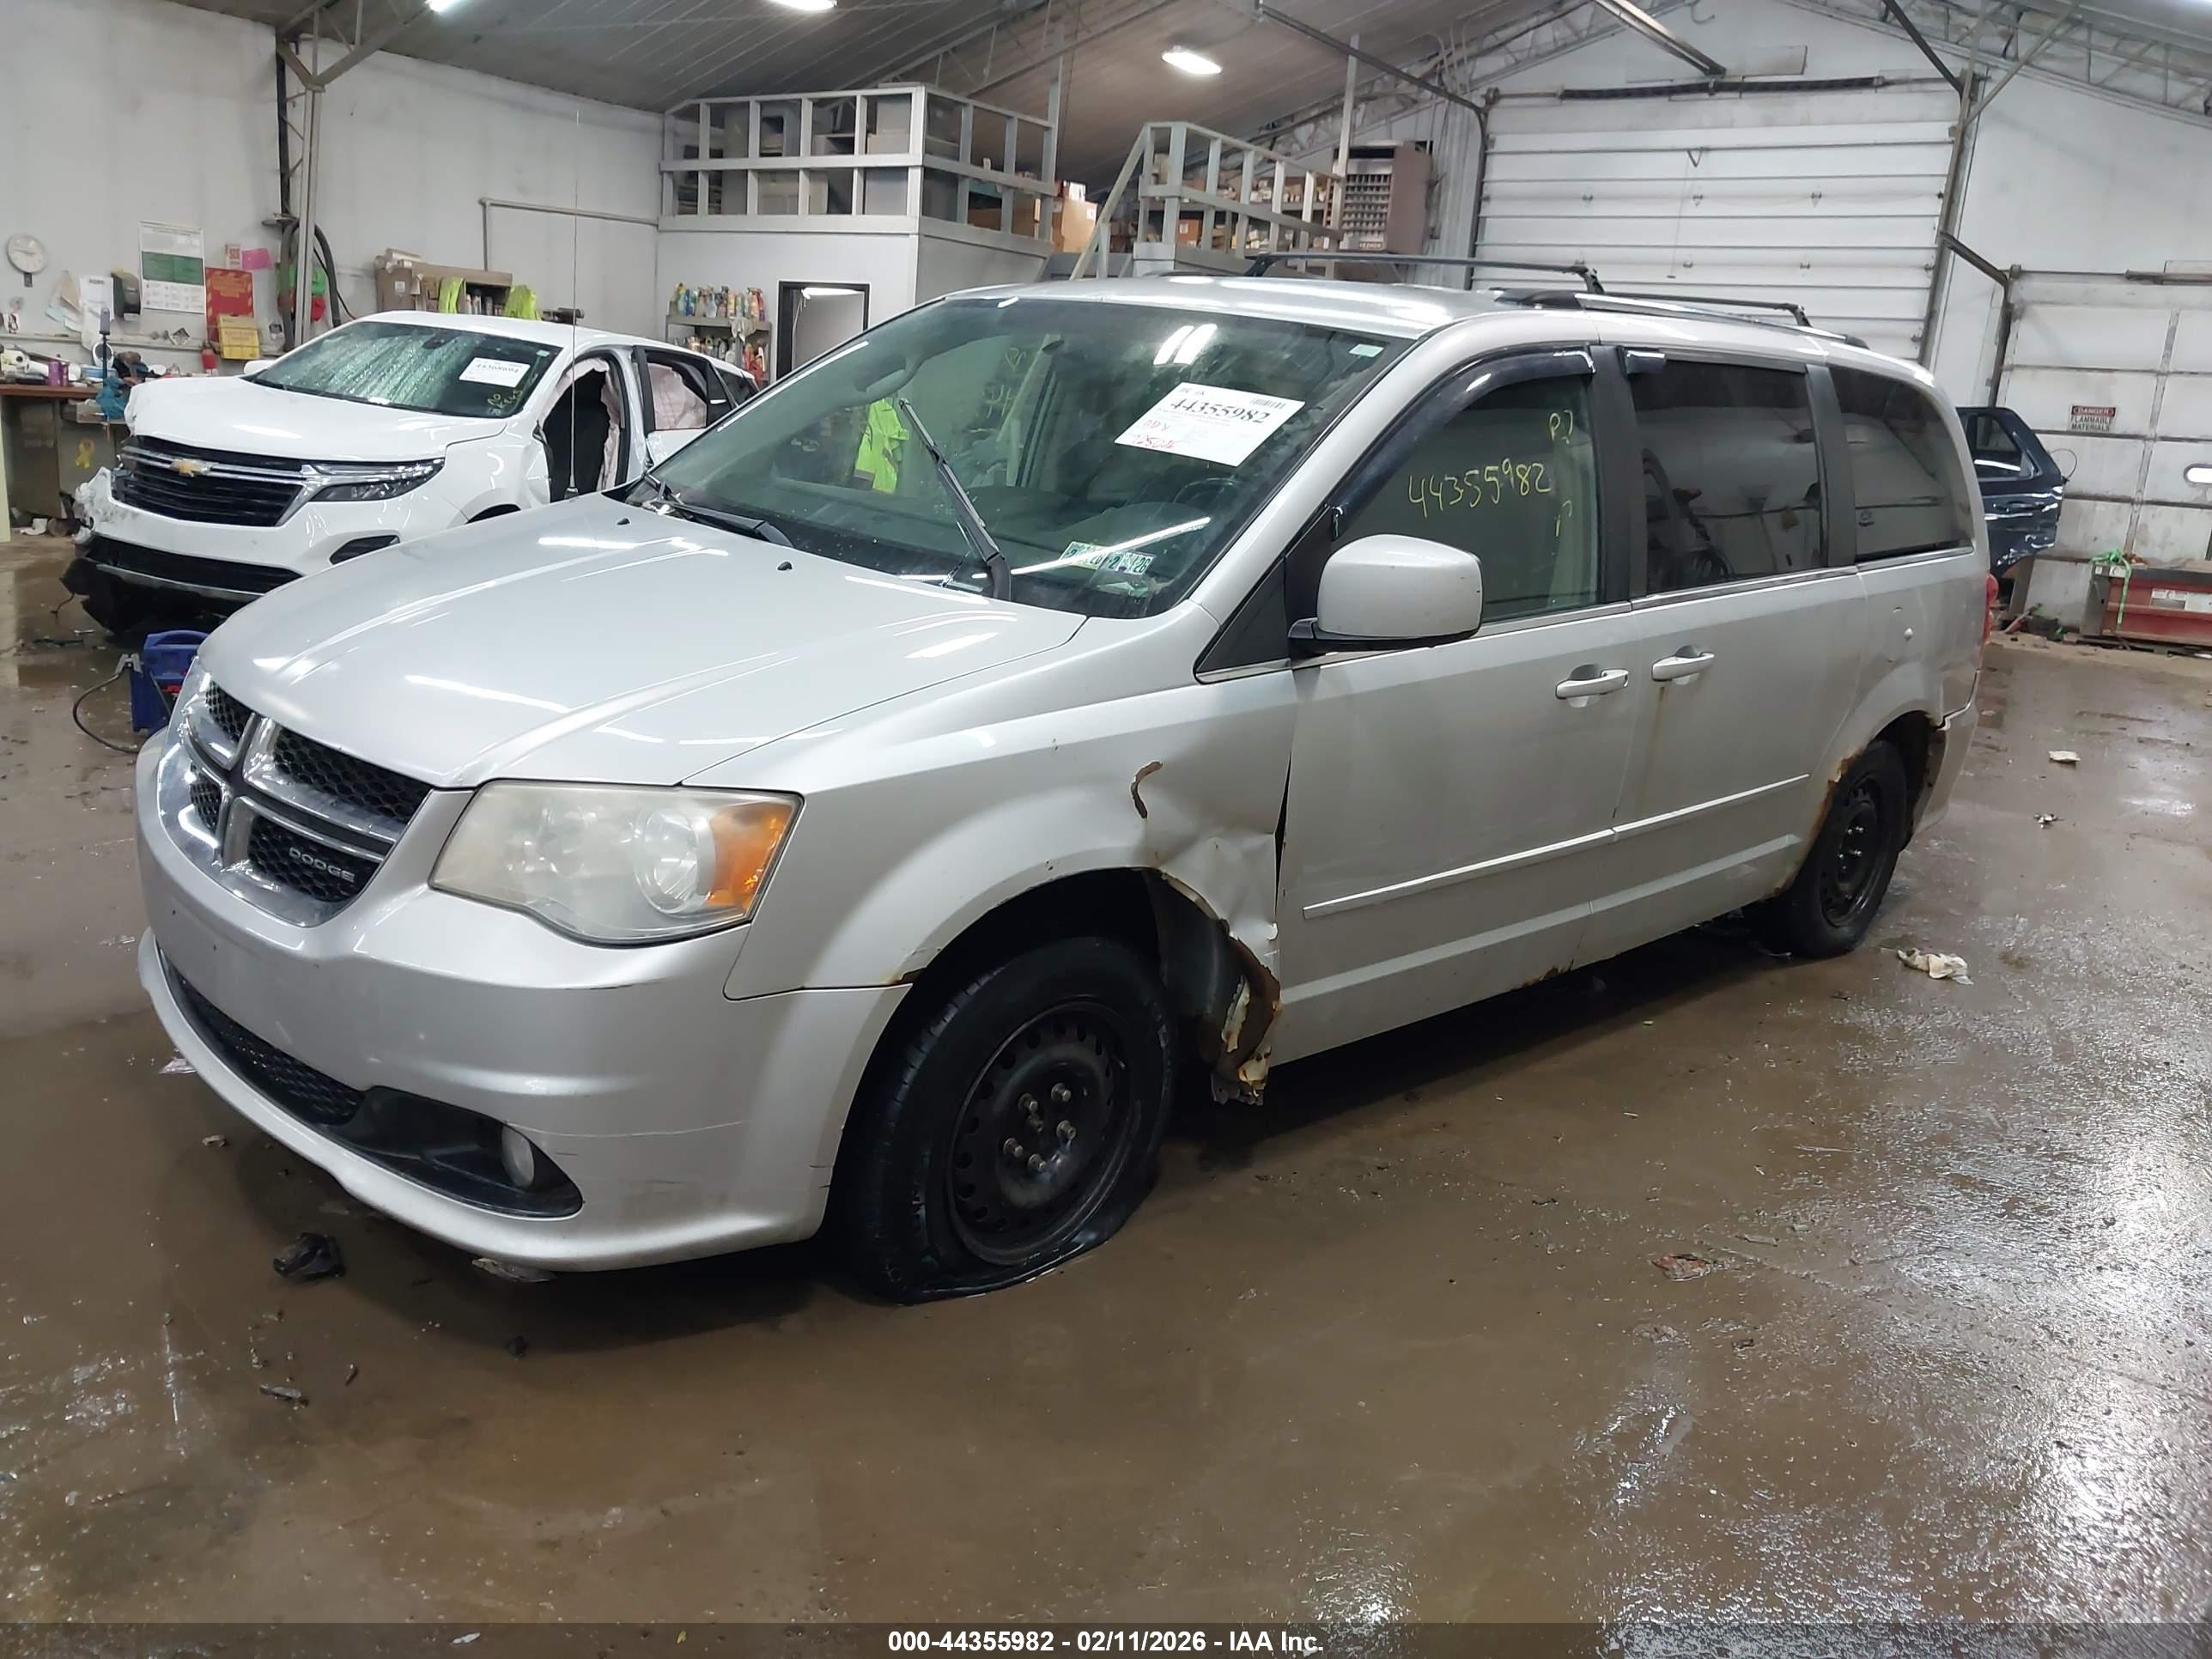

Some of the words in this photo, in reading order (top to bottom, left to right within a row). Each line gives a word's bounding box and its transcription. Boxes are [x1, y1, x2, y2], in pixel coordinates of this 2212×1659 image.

[1170, 398, 1271, 423] 44355982
[1408, 457, 1553, 519] 44355982
[289, 847, 356, 883] DODGE
